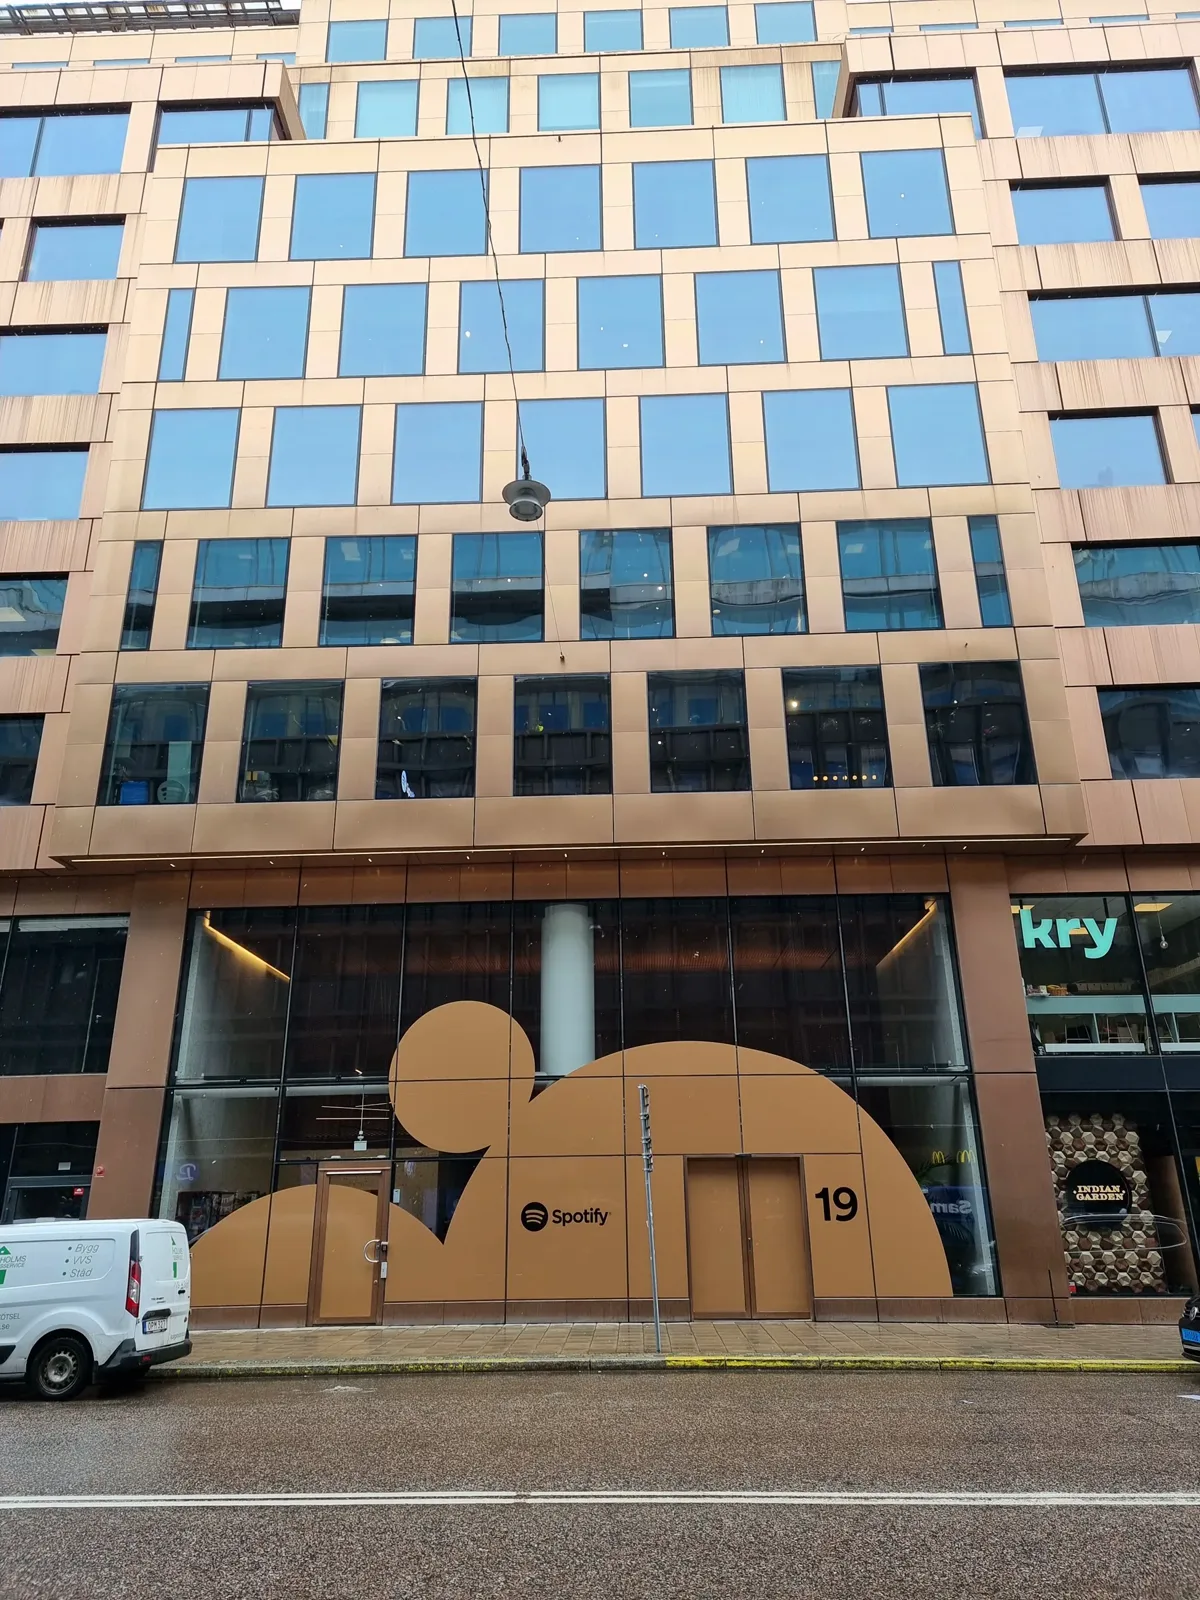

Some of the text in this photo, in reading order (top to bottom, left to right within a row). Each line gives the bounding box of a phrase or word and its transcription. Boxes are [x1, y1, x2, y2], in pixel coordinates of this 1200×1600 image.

[1019, 908, 1118, 959] kry
[1076, 1185, 1120, 1193] INDIAN
[1075, 1193, 1124, 1201] GARDEN
[814, 1186, 858, 1222] 19
[551, 1207, 609, 1227] Spotify
[74, 1243, 100, 1254] Bygg
[73, 1255, 93, 1265] VVS
[0, 1312, 20, 1320] ÖTSEL
